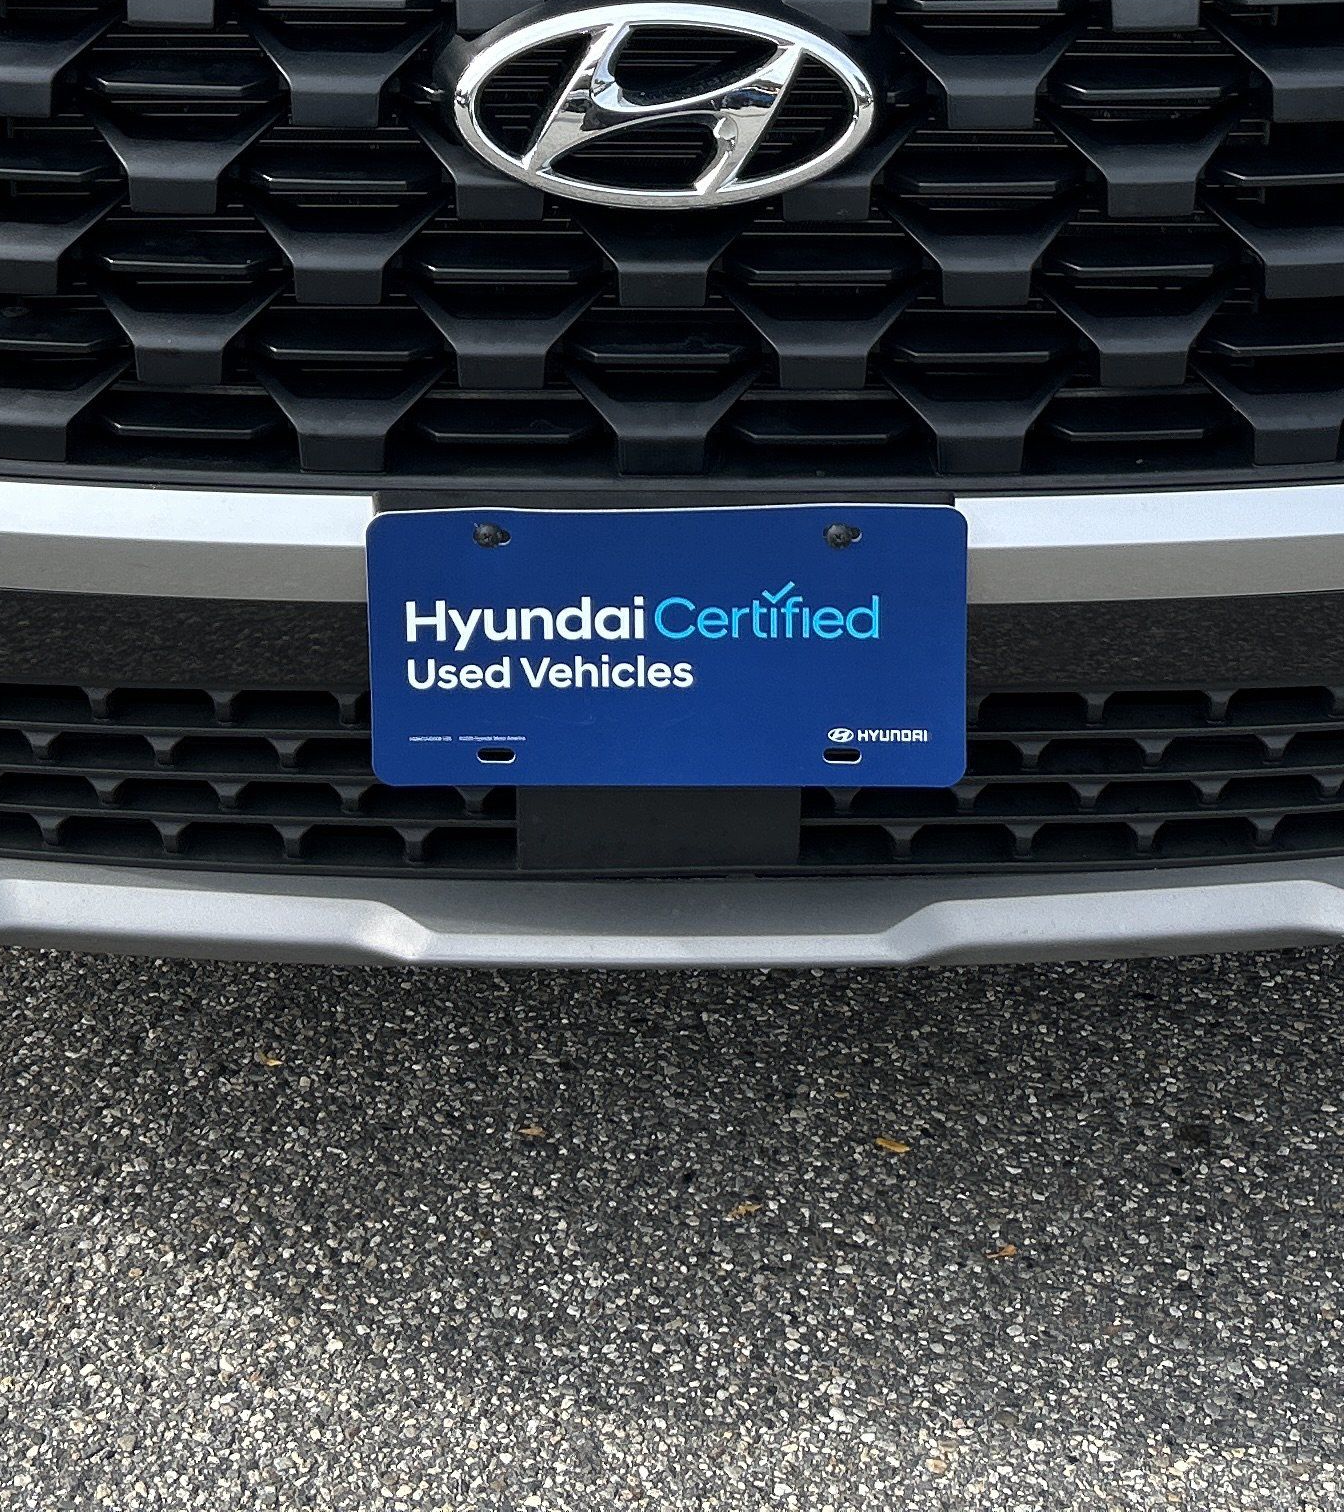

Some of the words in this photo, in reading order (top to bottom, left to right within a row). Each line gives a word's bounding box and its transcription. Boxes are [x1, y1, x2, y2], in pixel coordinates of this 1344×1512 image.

[405, 595, 645, 651] Hyundai
[654, 581, 880, 640] Certified
[407, 656, 511, 689] Used
[519, 654, 694, 689] Vehicles
[857, 729, 928, 743] HYUNDAI
